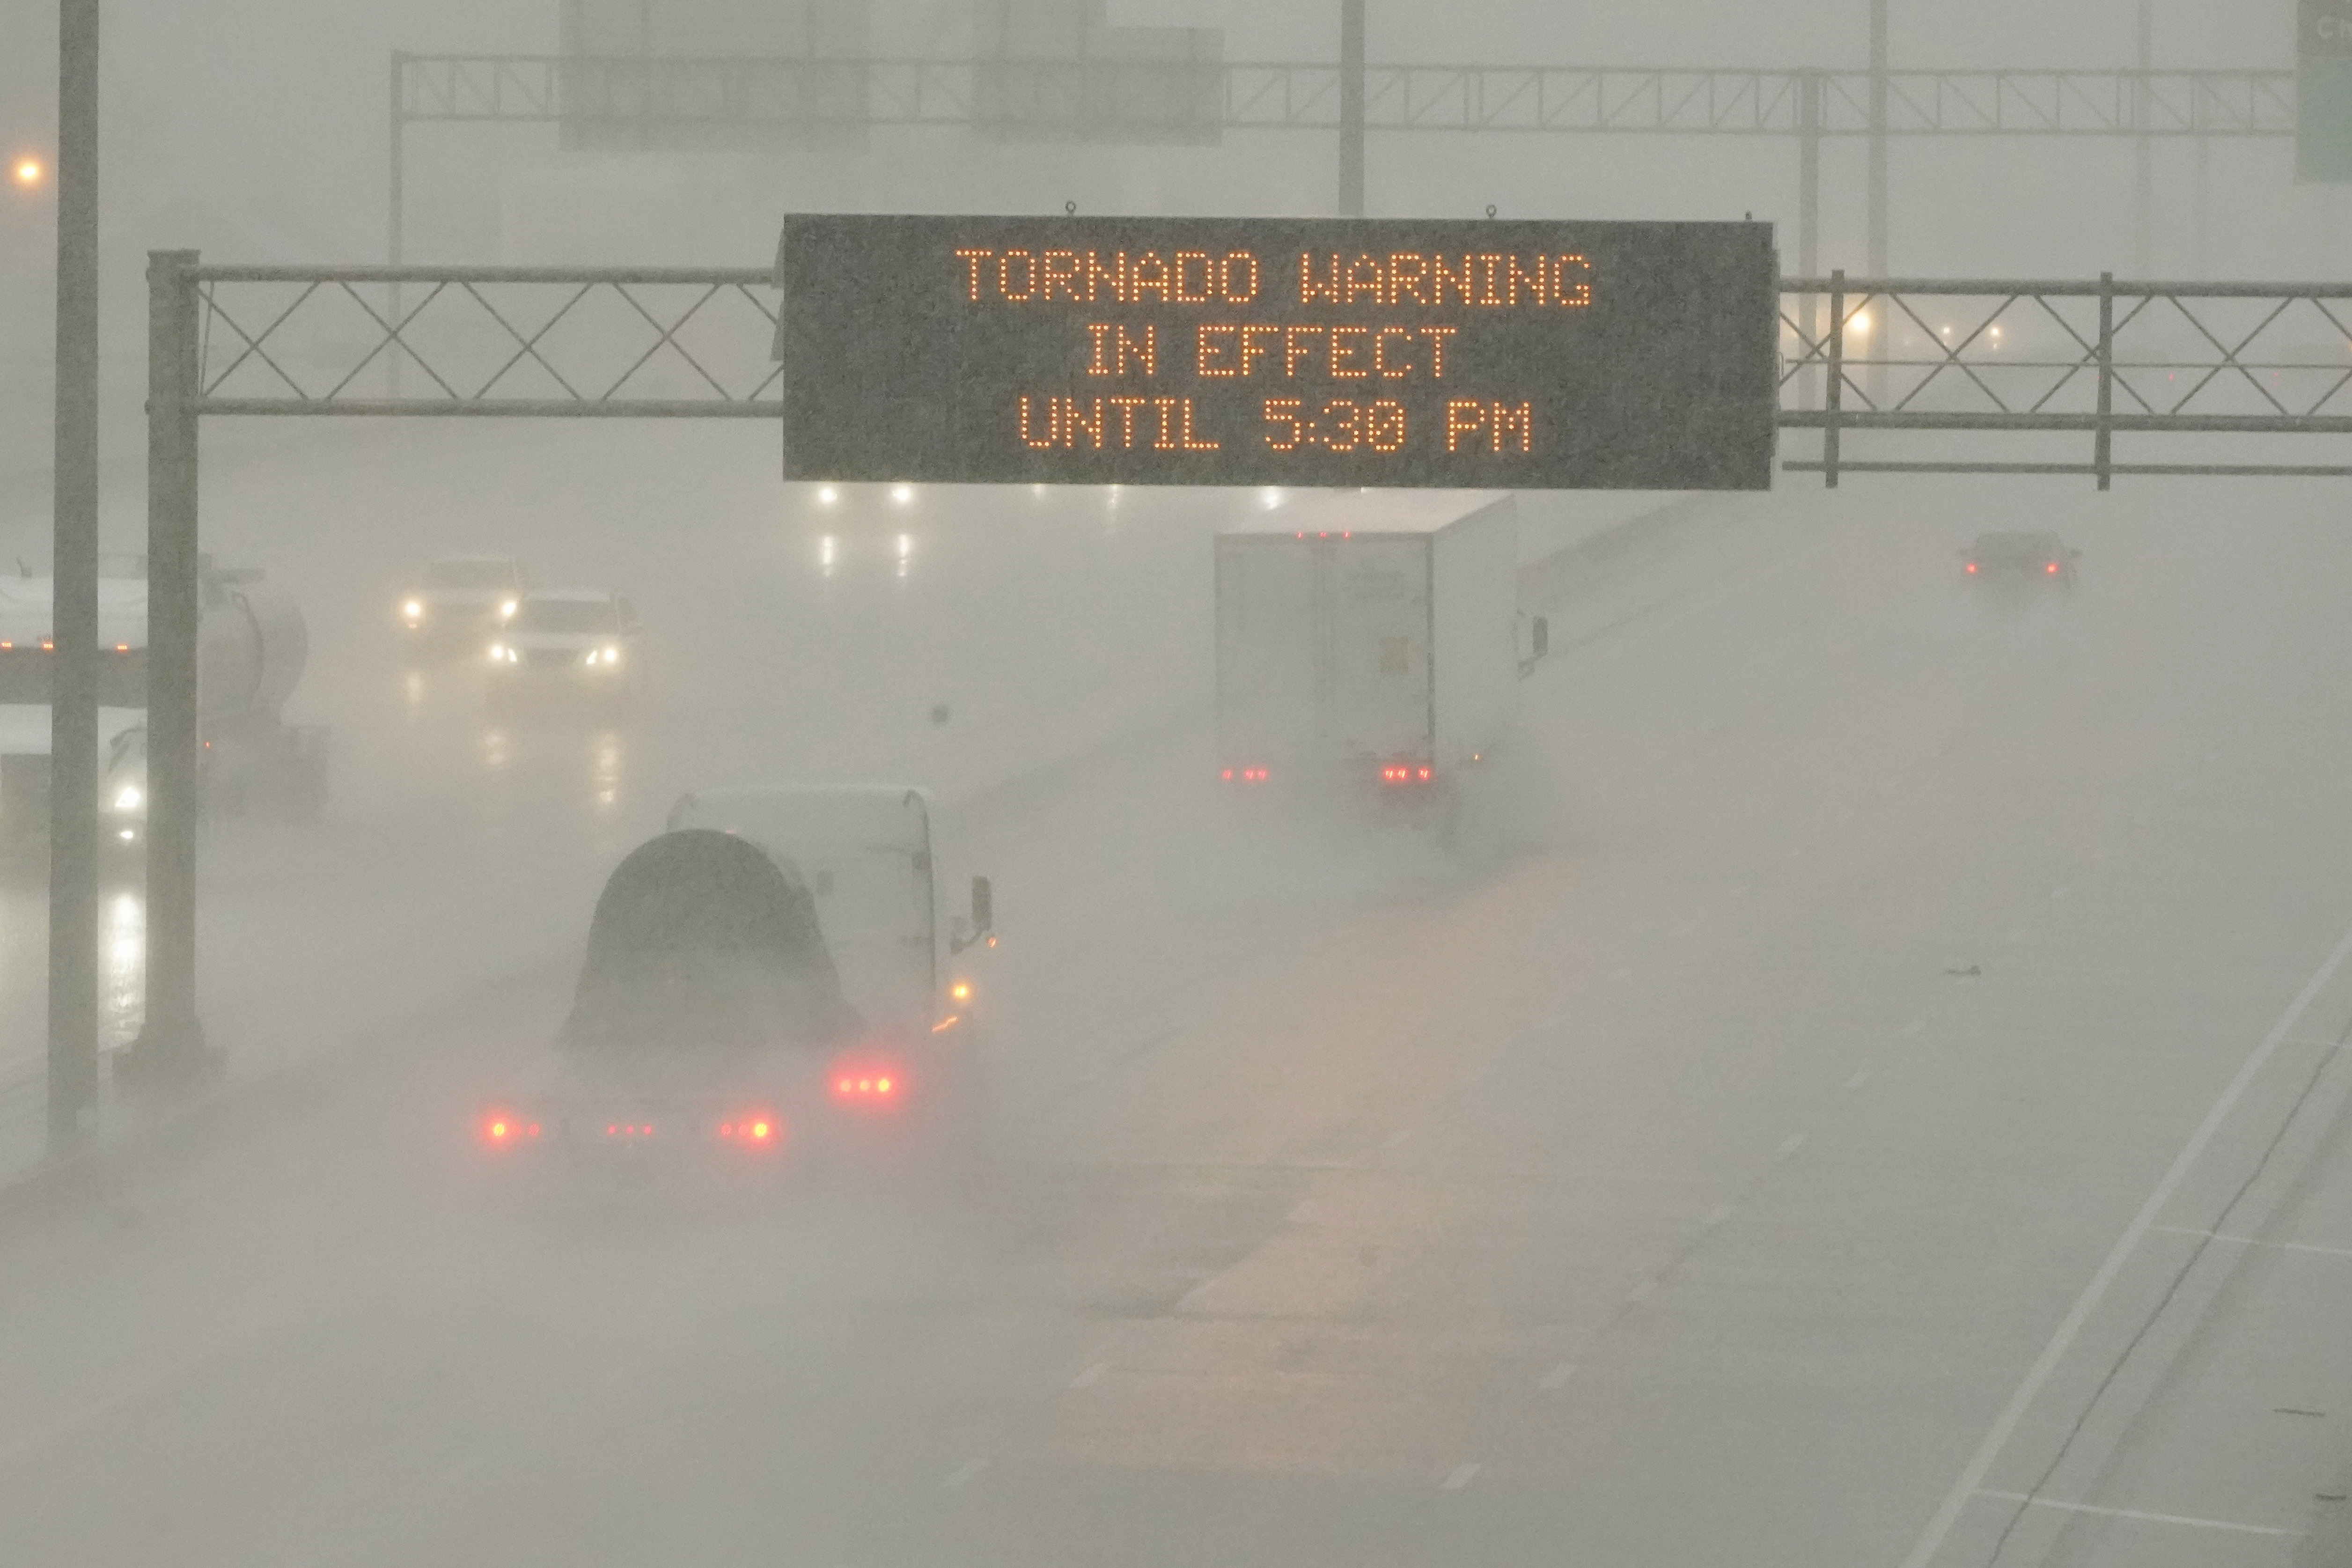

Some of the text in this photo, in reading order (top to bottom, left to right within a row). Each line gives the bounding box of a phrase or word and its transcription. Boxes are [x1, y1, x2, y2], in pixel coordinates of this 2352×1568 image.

[956, 250, 1590, 306] TORNADO WARNING
[1088, 324, 1456, 378] IN EFFECT
[1020, 397, 1531, 452] UNTIL 5:30 PM
